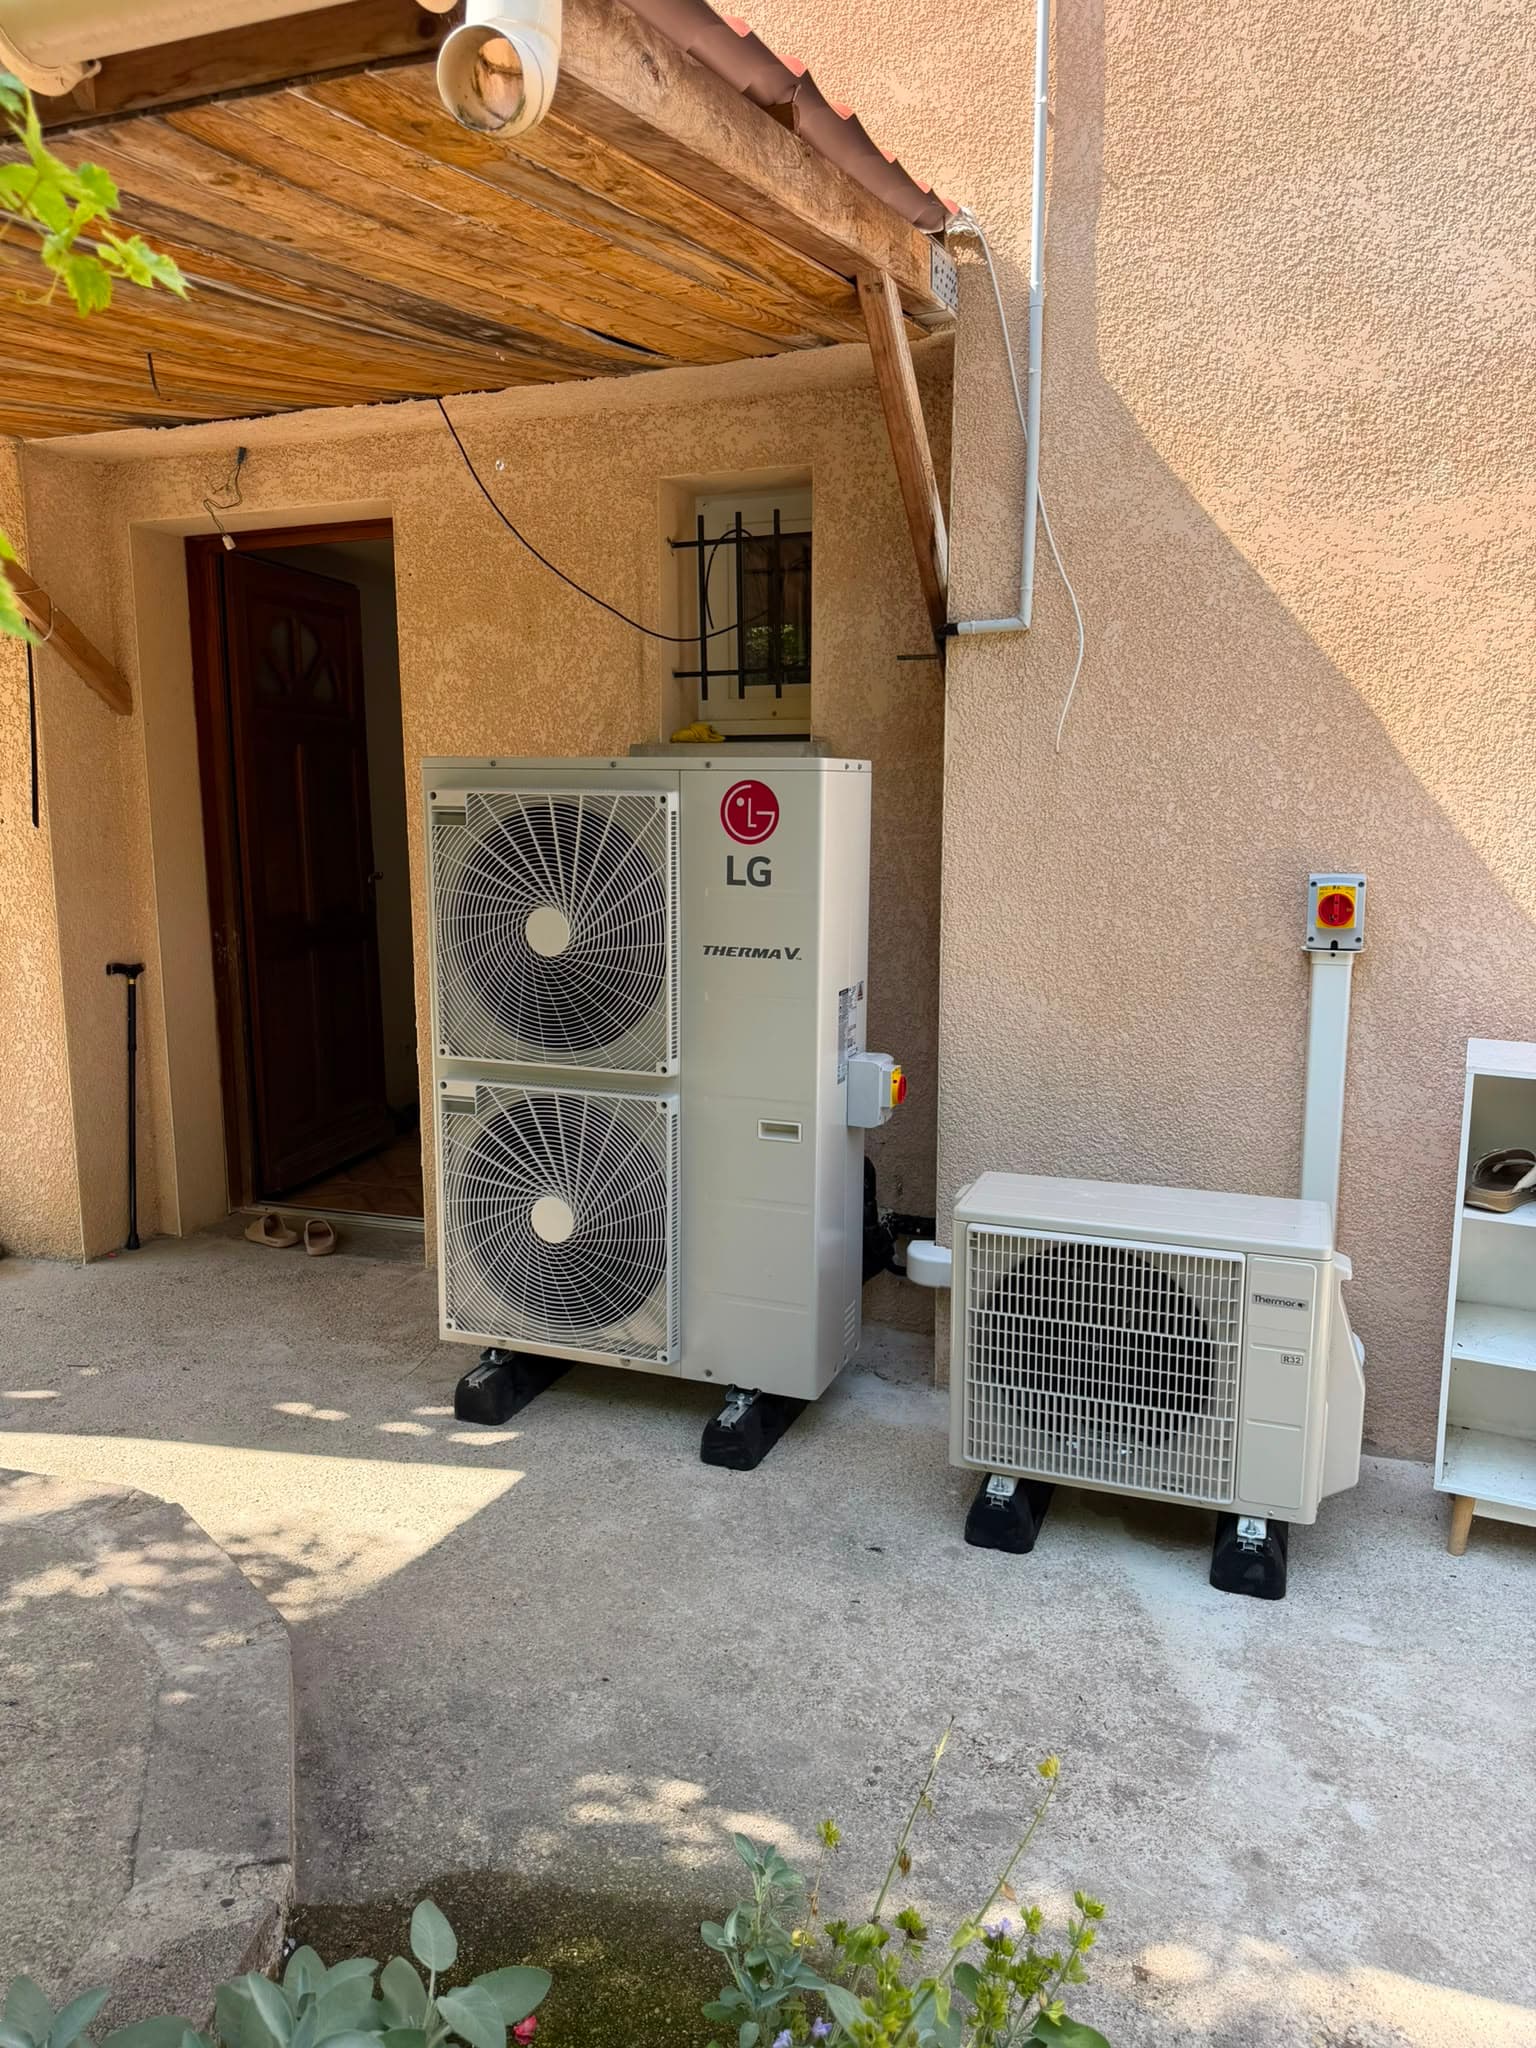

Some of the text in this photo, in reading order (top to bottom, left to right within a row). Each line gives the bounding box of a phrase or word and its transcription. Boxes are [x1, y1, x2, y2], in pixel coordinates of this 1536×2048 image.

[727, 855, 772, 887] LG
[703, 945, 781, 960] THERMA
[1254, 1294, 1296, 1308] Thermor
[1283, 1355, 1301, 1365] R32
